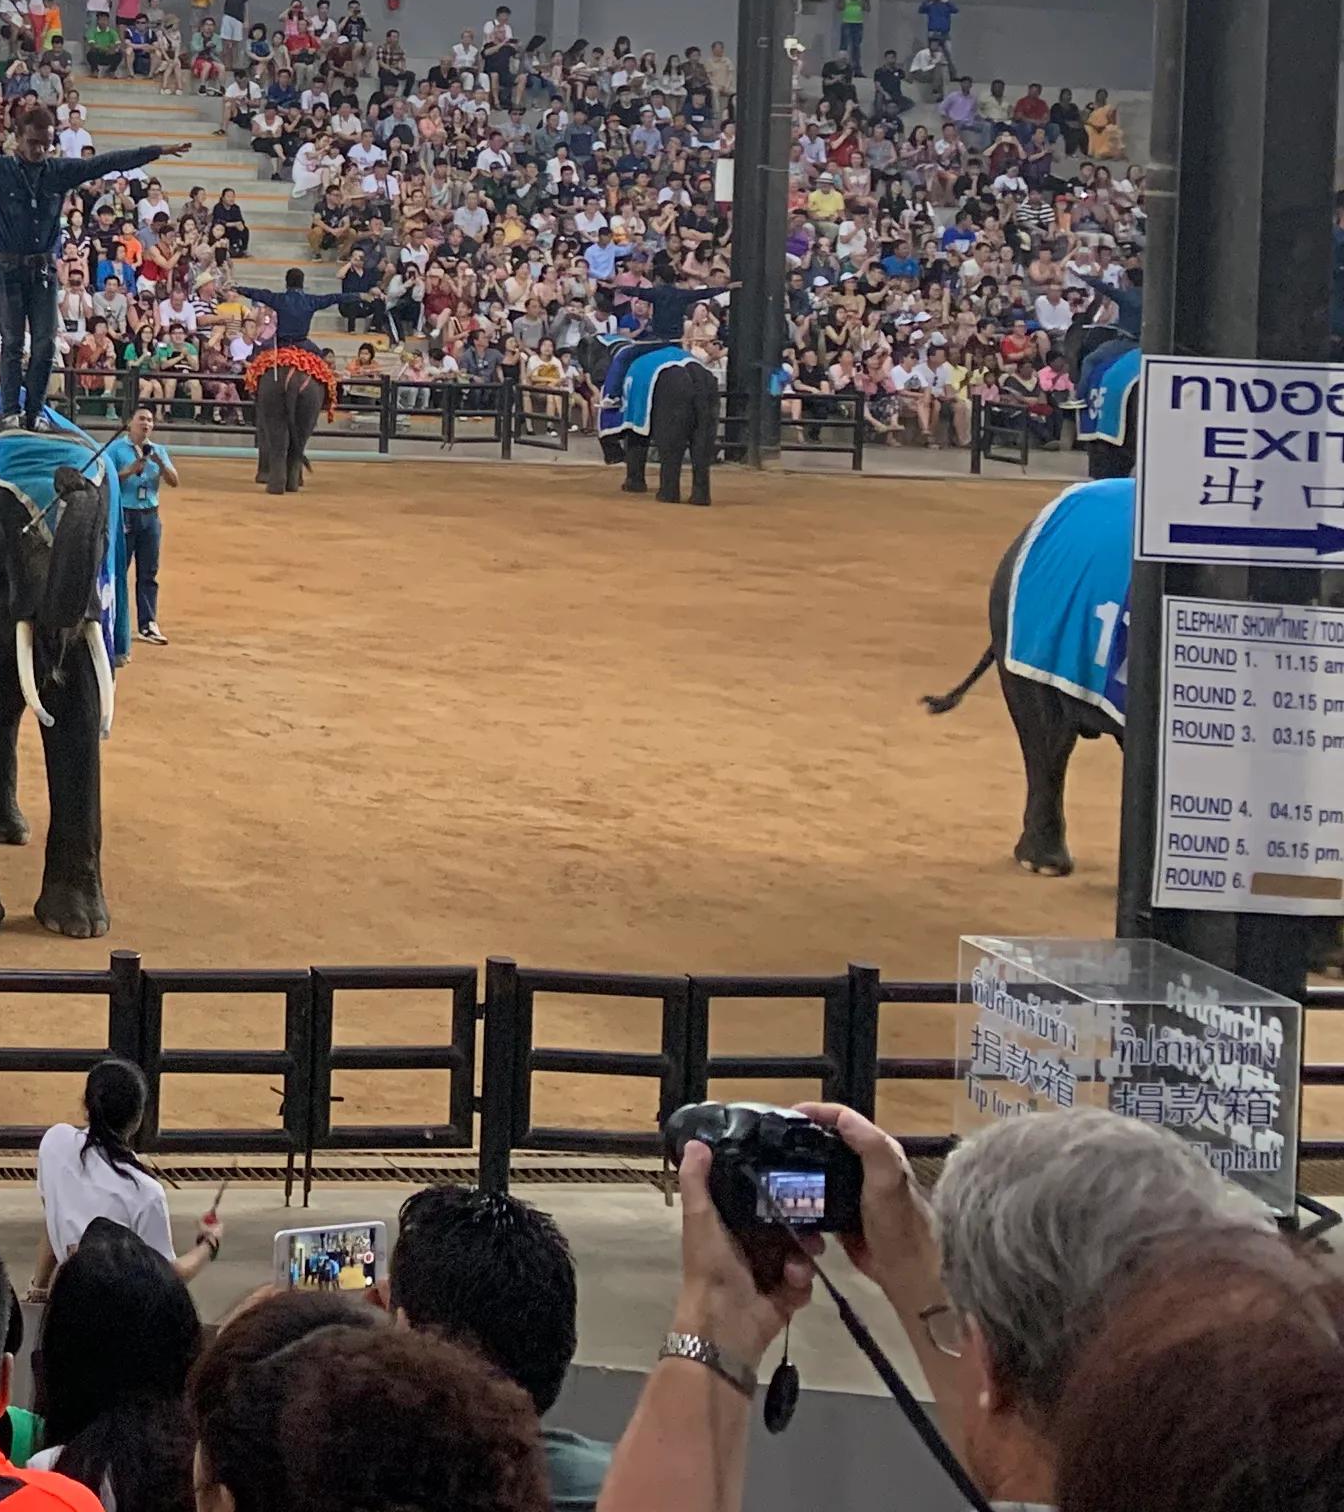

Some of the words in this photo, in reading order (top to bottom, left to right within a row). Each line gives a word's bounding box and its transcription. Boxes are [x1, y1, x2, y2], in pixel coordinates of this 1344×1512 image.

[1176, 609, 1239, 636] ELEPHANT
[1242, 615, 1278, 638] SHOW
[1280, 618, 1309, 640] TIME
[1174, 644, 1238, 666] ROUND
[1275, 654, 1318, 673] 11.15
[1173, 684, 1236, 705] ROUND
[1273, 691, 1317, 710] 02.15
[1172, 719, 1235, 741] ROUND
[1272, 727, 1316, 747] 03.15
[1170, 794, 1233, 815] ROUND
[1270, 802, 1313, 821] 04.15
[1168, 832, 1230, 854] ROUND
[1266, 841, 1309, 859] 05.15
[1165, 867, 1226, 887] ROUND
[970, 1023, 1078, 1109] 捐款箱
[967, 1072, 988, 1113] Tip
[1114, 1081, 1274, 1126] 捐款箱
